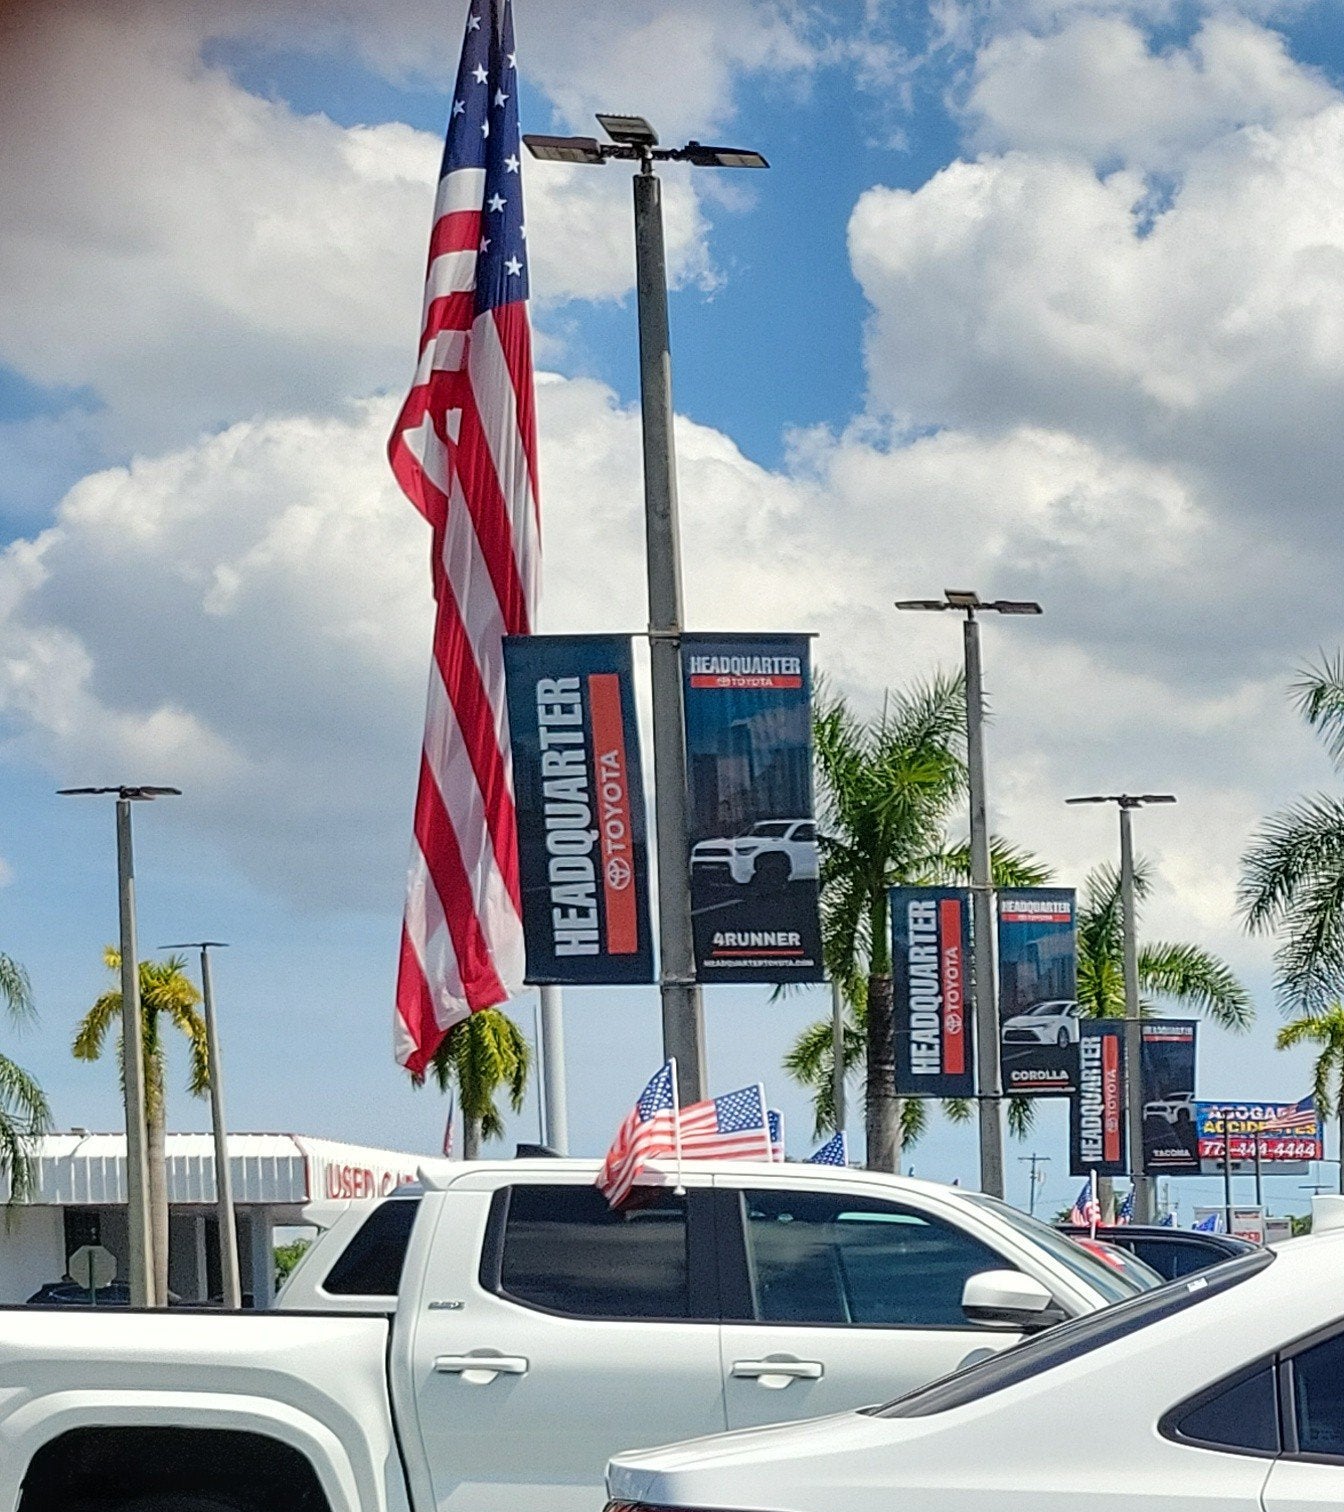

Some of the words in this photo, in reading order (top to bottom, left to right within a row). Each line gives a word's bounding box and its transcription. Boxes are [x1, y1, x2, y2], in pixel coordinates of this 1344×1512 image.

[691, 656, 801, 676] HEADQUARTER
[536, 676, 600, 957] HEADQUARTER
[602, 749, 626, 854] TOYOTA
[713, 931, 801, 947] 4RUNNER
[907, 900, 943, 1075] HEADQUARTER
[944, 946, 961, 1012] TOYOTA
[1011, 1069, 1069, 1081] COROLLA
[1080, 1036, 1106, 1162] HEADQUARTER
[327, 1163, 376, 1199] USED
